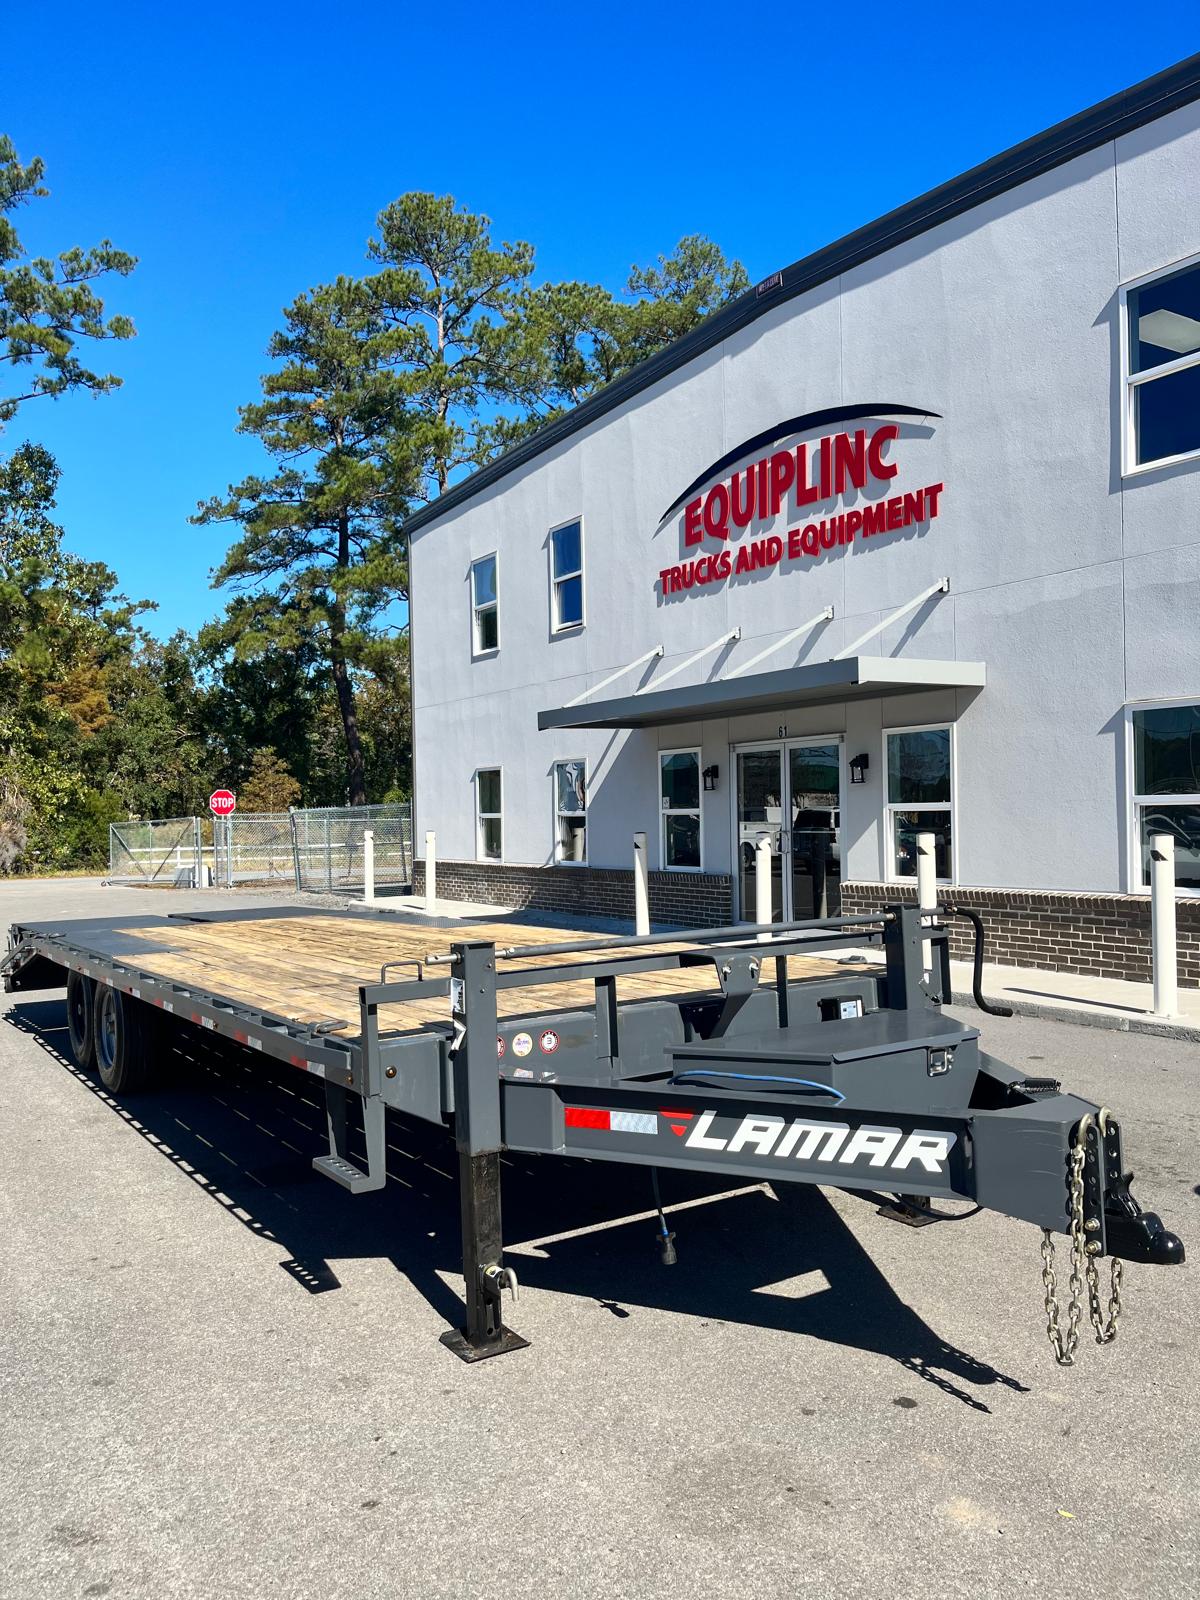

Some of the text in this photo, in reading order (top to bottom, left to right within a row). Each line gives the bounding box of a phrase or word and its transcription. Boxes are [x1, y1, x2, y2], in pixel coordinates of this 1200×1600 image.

[684, 425, 900, 548] EQUIPLINC
[659, 482, 944, 596] TRUCKS AND EQUIPMENT
[778, 725, 788, 738] 61
[211, 797, 234, 808] STOP
[685, 1110, 958, 1173] LAMAR
